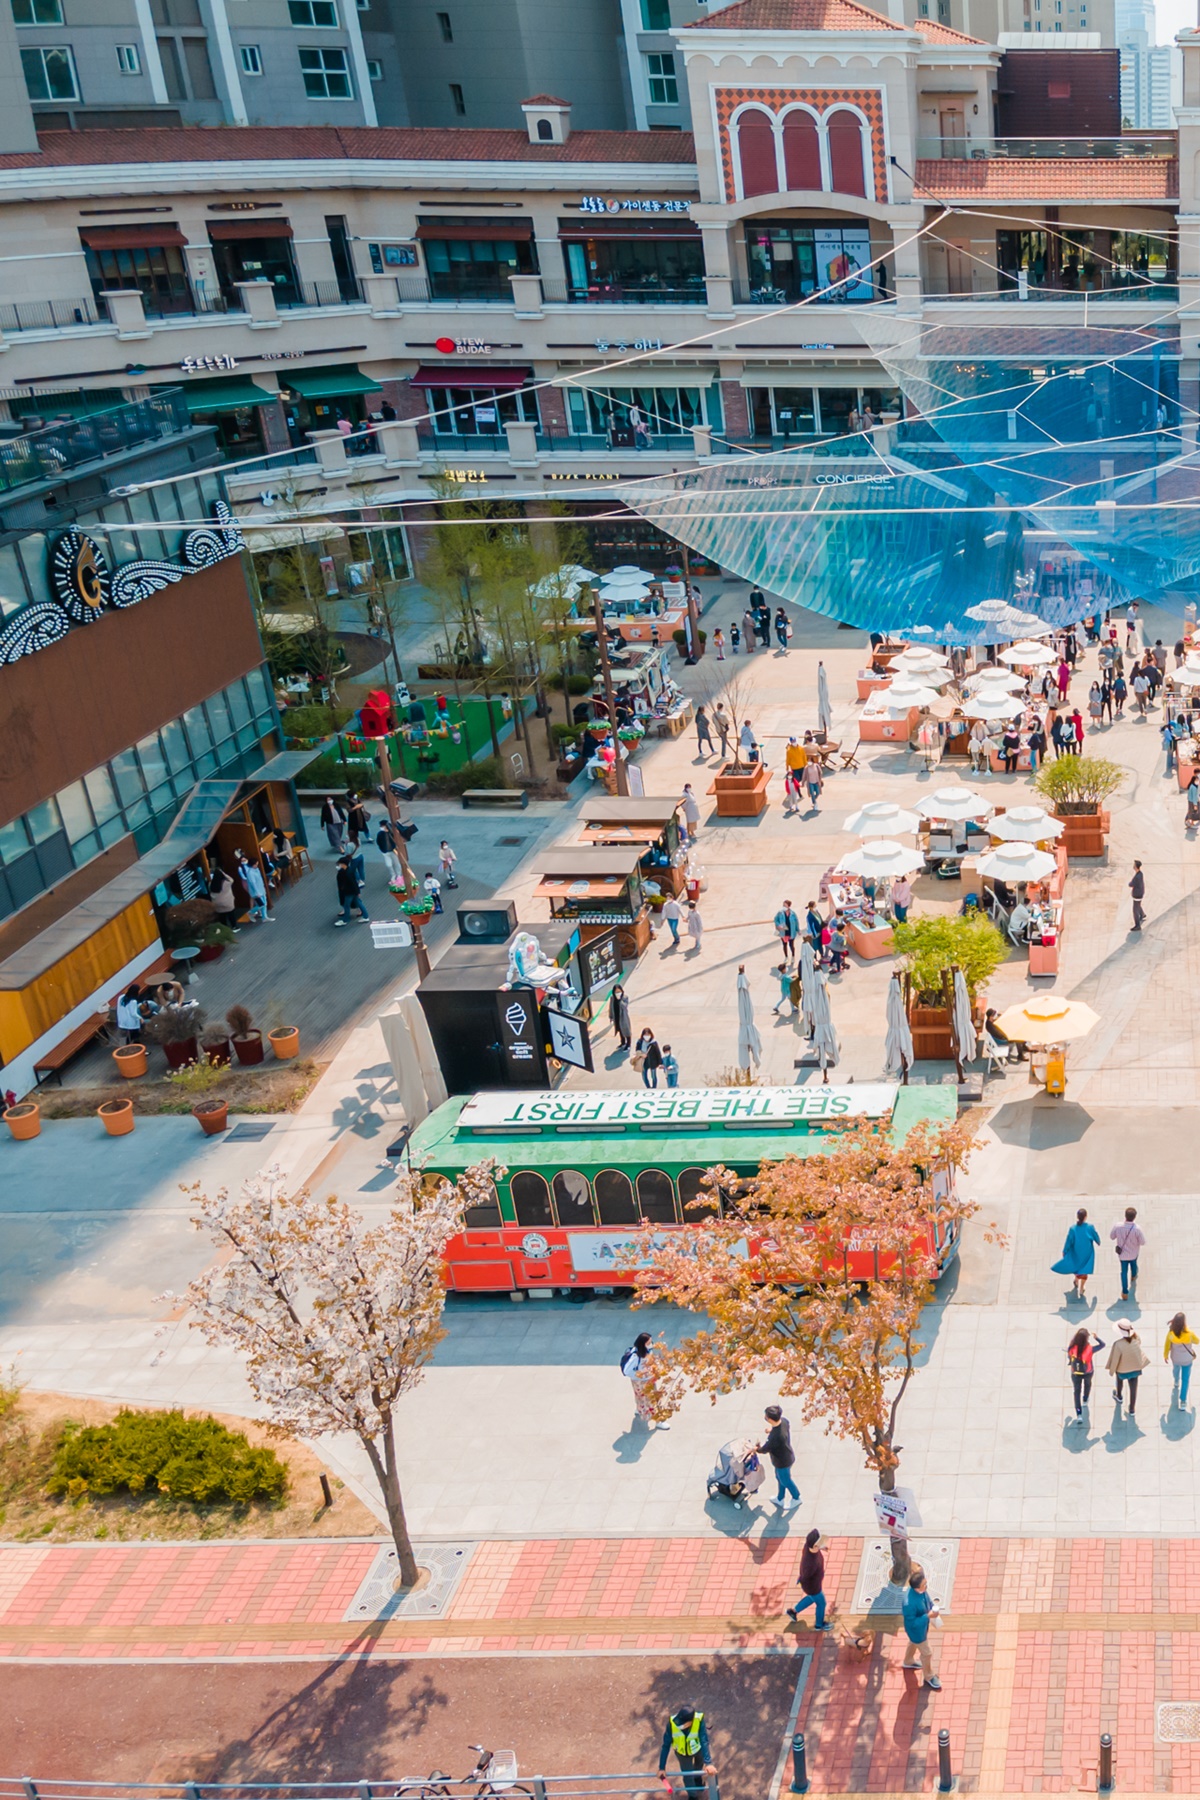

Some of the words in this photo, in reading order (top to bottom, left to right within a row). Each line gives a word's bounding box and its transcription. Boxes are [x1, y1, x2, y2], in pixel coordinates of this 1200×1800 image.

[622, 200, 661, 212] 카이센동
[455, 338, 484, 346] STEW
[456, 345, 491, 354] BUDAE
[634, 337, 662, 353] 하나
[815, 474, 891, 484] CONCIERGE
[504, 1101, 600, 1122] FIRST
[608, 1099, 698, 1120] BEST
[708, 1097, 774, 1117] THE
[783, 1095, 852, 1115] SEE
